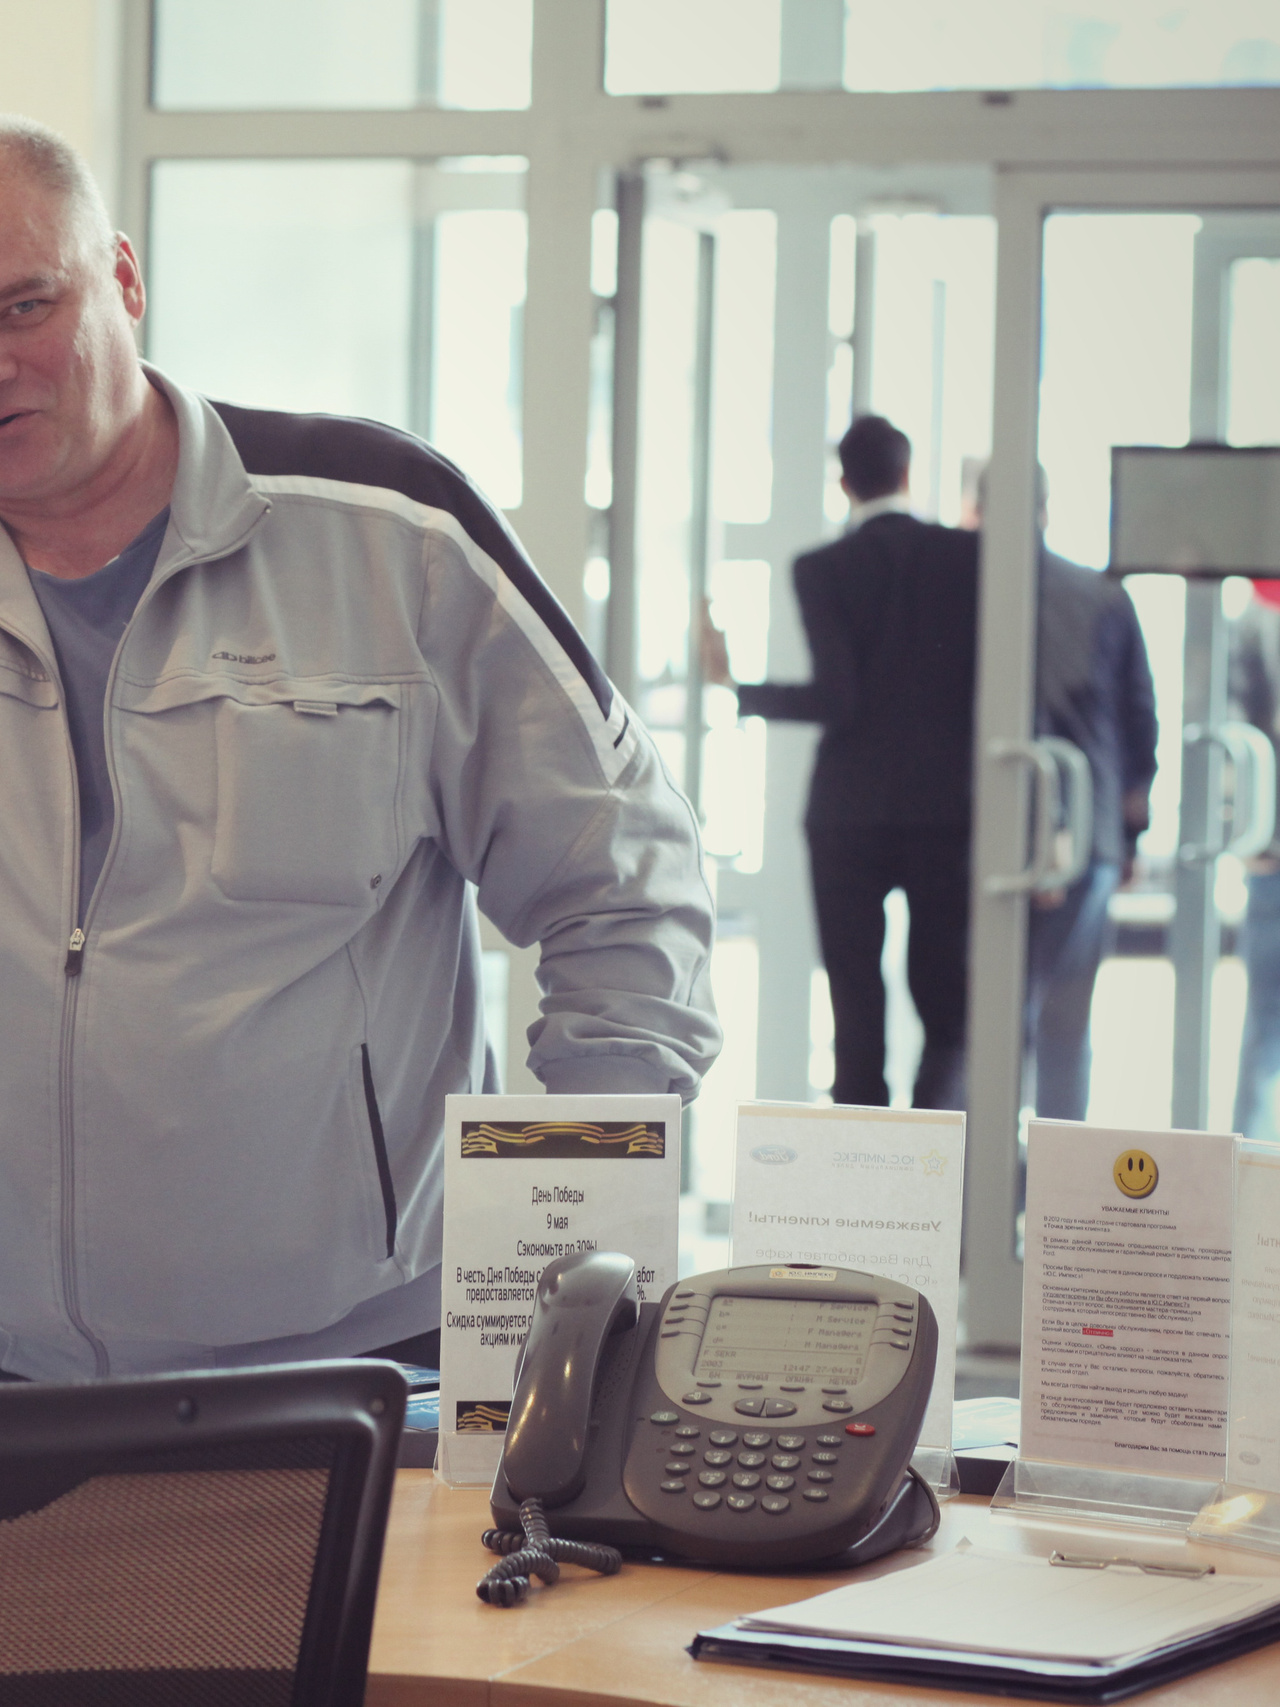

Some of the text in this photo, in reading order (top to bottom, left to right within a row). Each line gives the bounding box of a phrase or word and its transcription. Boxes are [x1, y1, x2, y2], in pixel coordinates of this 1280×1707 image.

[531, 1186, 585, 1206] День Победы
[546, 1213, 569, 1230] 9 мая
[516, 1239, 563, 1257] Сэкономьте
[564, 1243, 575, 1256] до
[456, 1267, 462, 1283] В
[463, 1270, 486, 1283] честь
[486, 1267, 503, 1286] Дня
[504, 1266, 535, 1286] Победы
[636, 1266, 655, 1283] абот
[465, 1288, 535, 1304] предоставляется
[446, 1311, 475, 1331] Скидка
[476, 1315, 527, 1331] суммируется
[827, 1316, 865, 1325] Service
[480, 1333, 509, 1349] акциям
[510, 1333, 516, 1346] и
